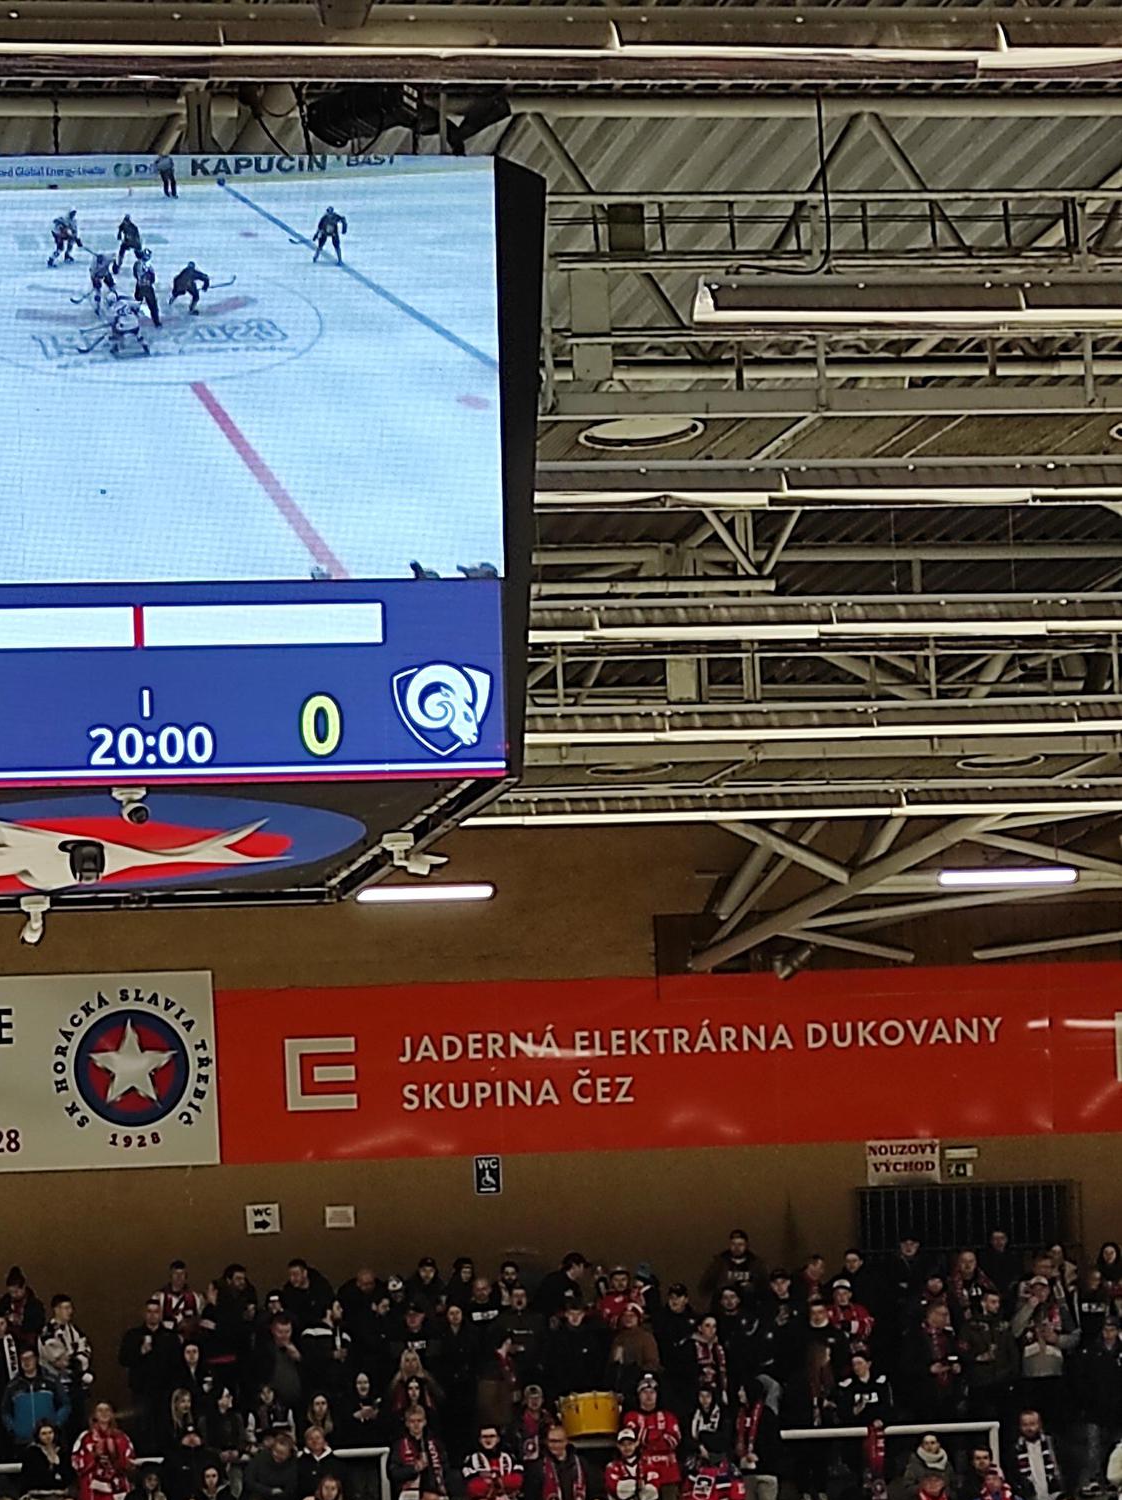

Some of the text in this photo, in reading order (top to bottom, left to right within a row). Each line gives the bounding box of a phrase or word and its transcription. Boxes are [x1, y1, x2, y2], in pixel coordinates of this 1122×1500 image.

[302, 695, 341, 756] 0
[89, 726, 213, 765] 20:00
[399, 1016, 1003, 1063] JADERNÁ ELEKTRÁRNA DUKOVANY
[53, 988, 213, 1128] SK HORÁCKÁ SLAVIA TŘEBÍČ
[402, 1069, 635, 1111] SKUPINA ČEZ
[109, 1131, 162, 1148] 1928
[867, 1140, 939, 1157] NOUZOVÝ
[477, 1158, 498, 1169] WC
[872, 1157, 937, 1174] VÝCHOD
[252, 1207, 273, 1217] WC
